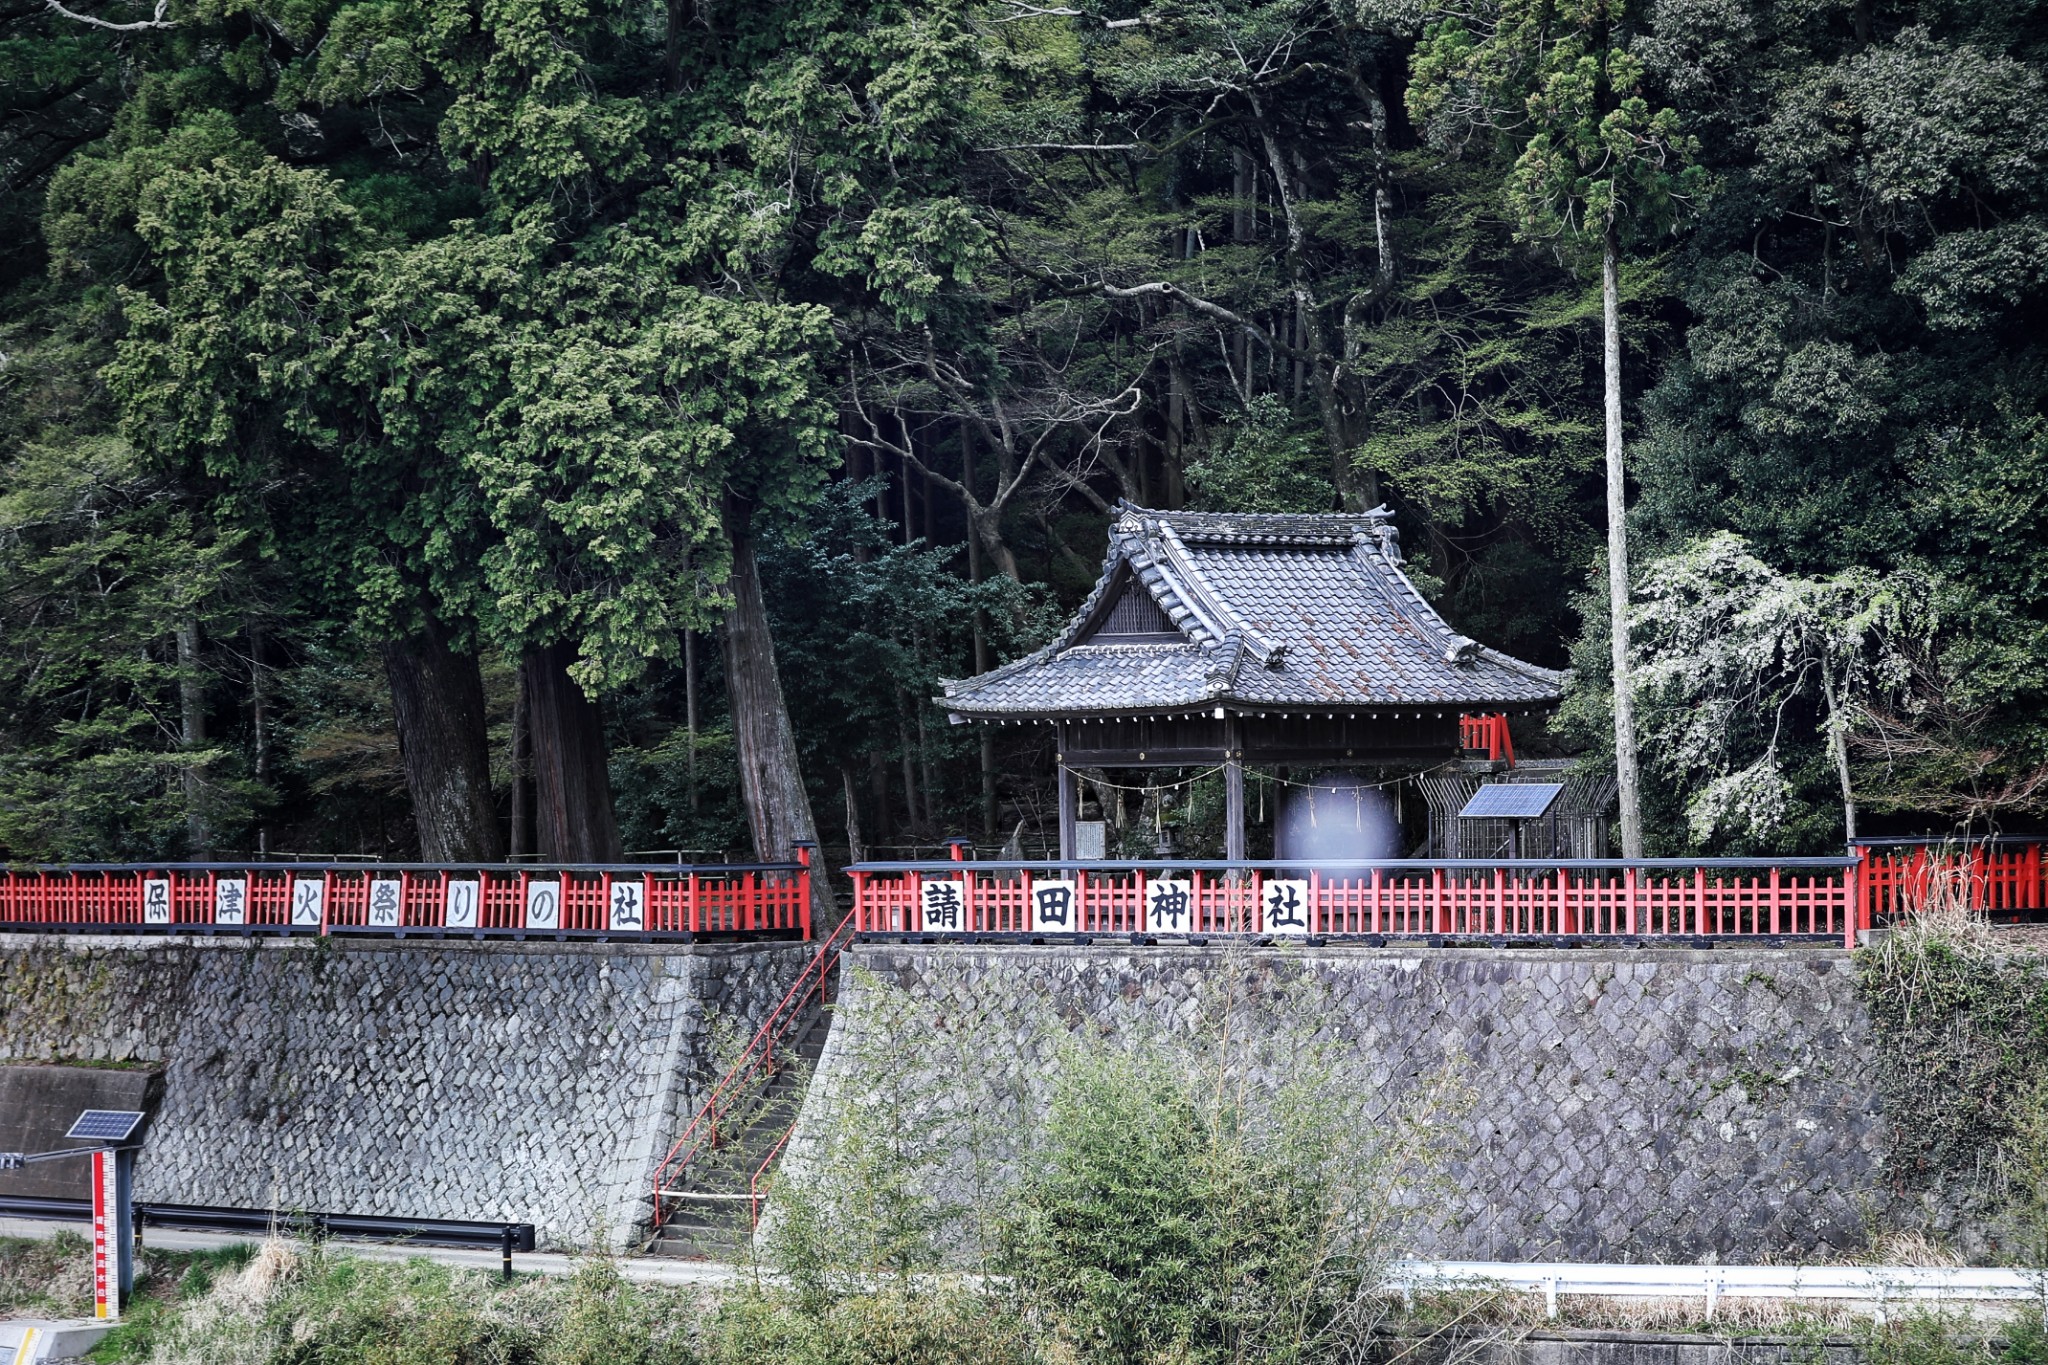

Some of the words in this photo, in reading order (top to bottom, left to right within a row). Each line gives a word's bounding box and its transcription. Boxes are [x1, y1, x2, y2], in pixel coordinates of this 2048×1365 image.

[147, 883, 167, 919] 保
[218, 882, 242, 921] 津
[294, 884, 319, 922] 火
[372, 882, 398, 922] 祭
[455, 886, 470, 921] り
[532, 890, 554, 922] の
[612, 885, 641, 926] 社
[925, 884, 960, 929] 請
[1036, 886, 1071, 925] 田
[1150, 883, 1188, 929] 神
[1266, 885, 1306, 928] 社
